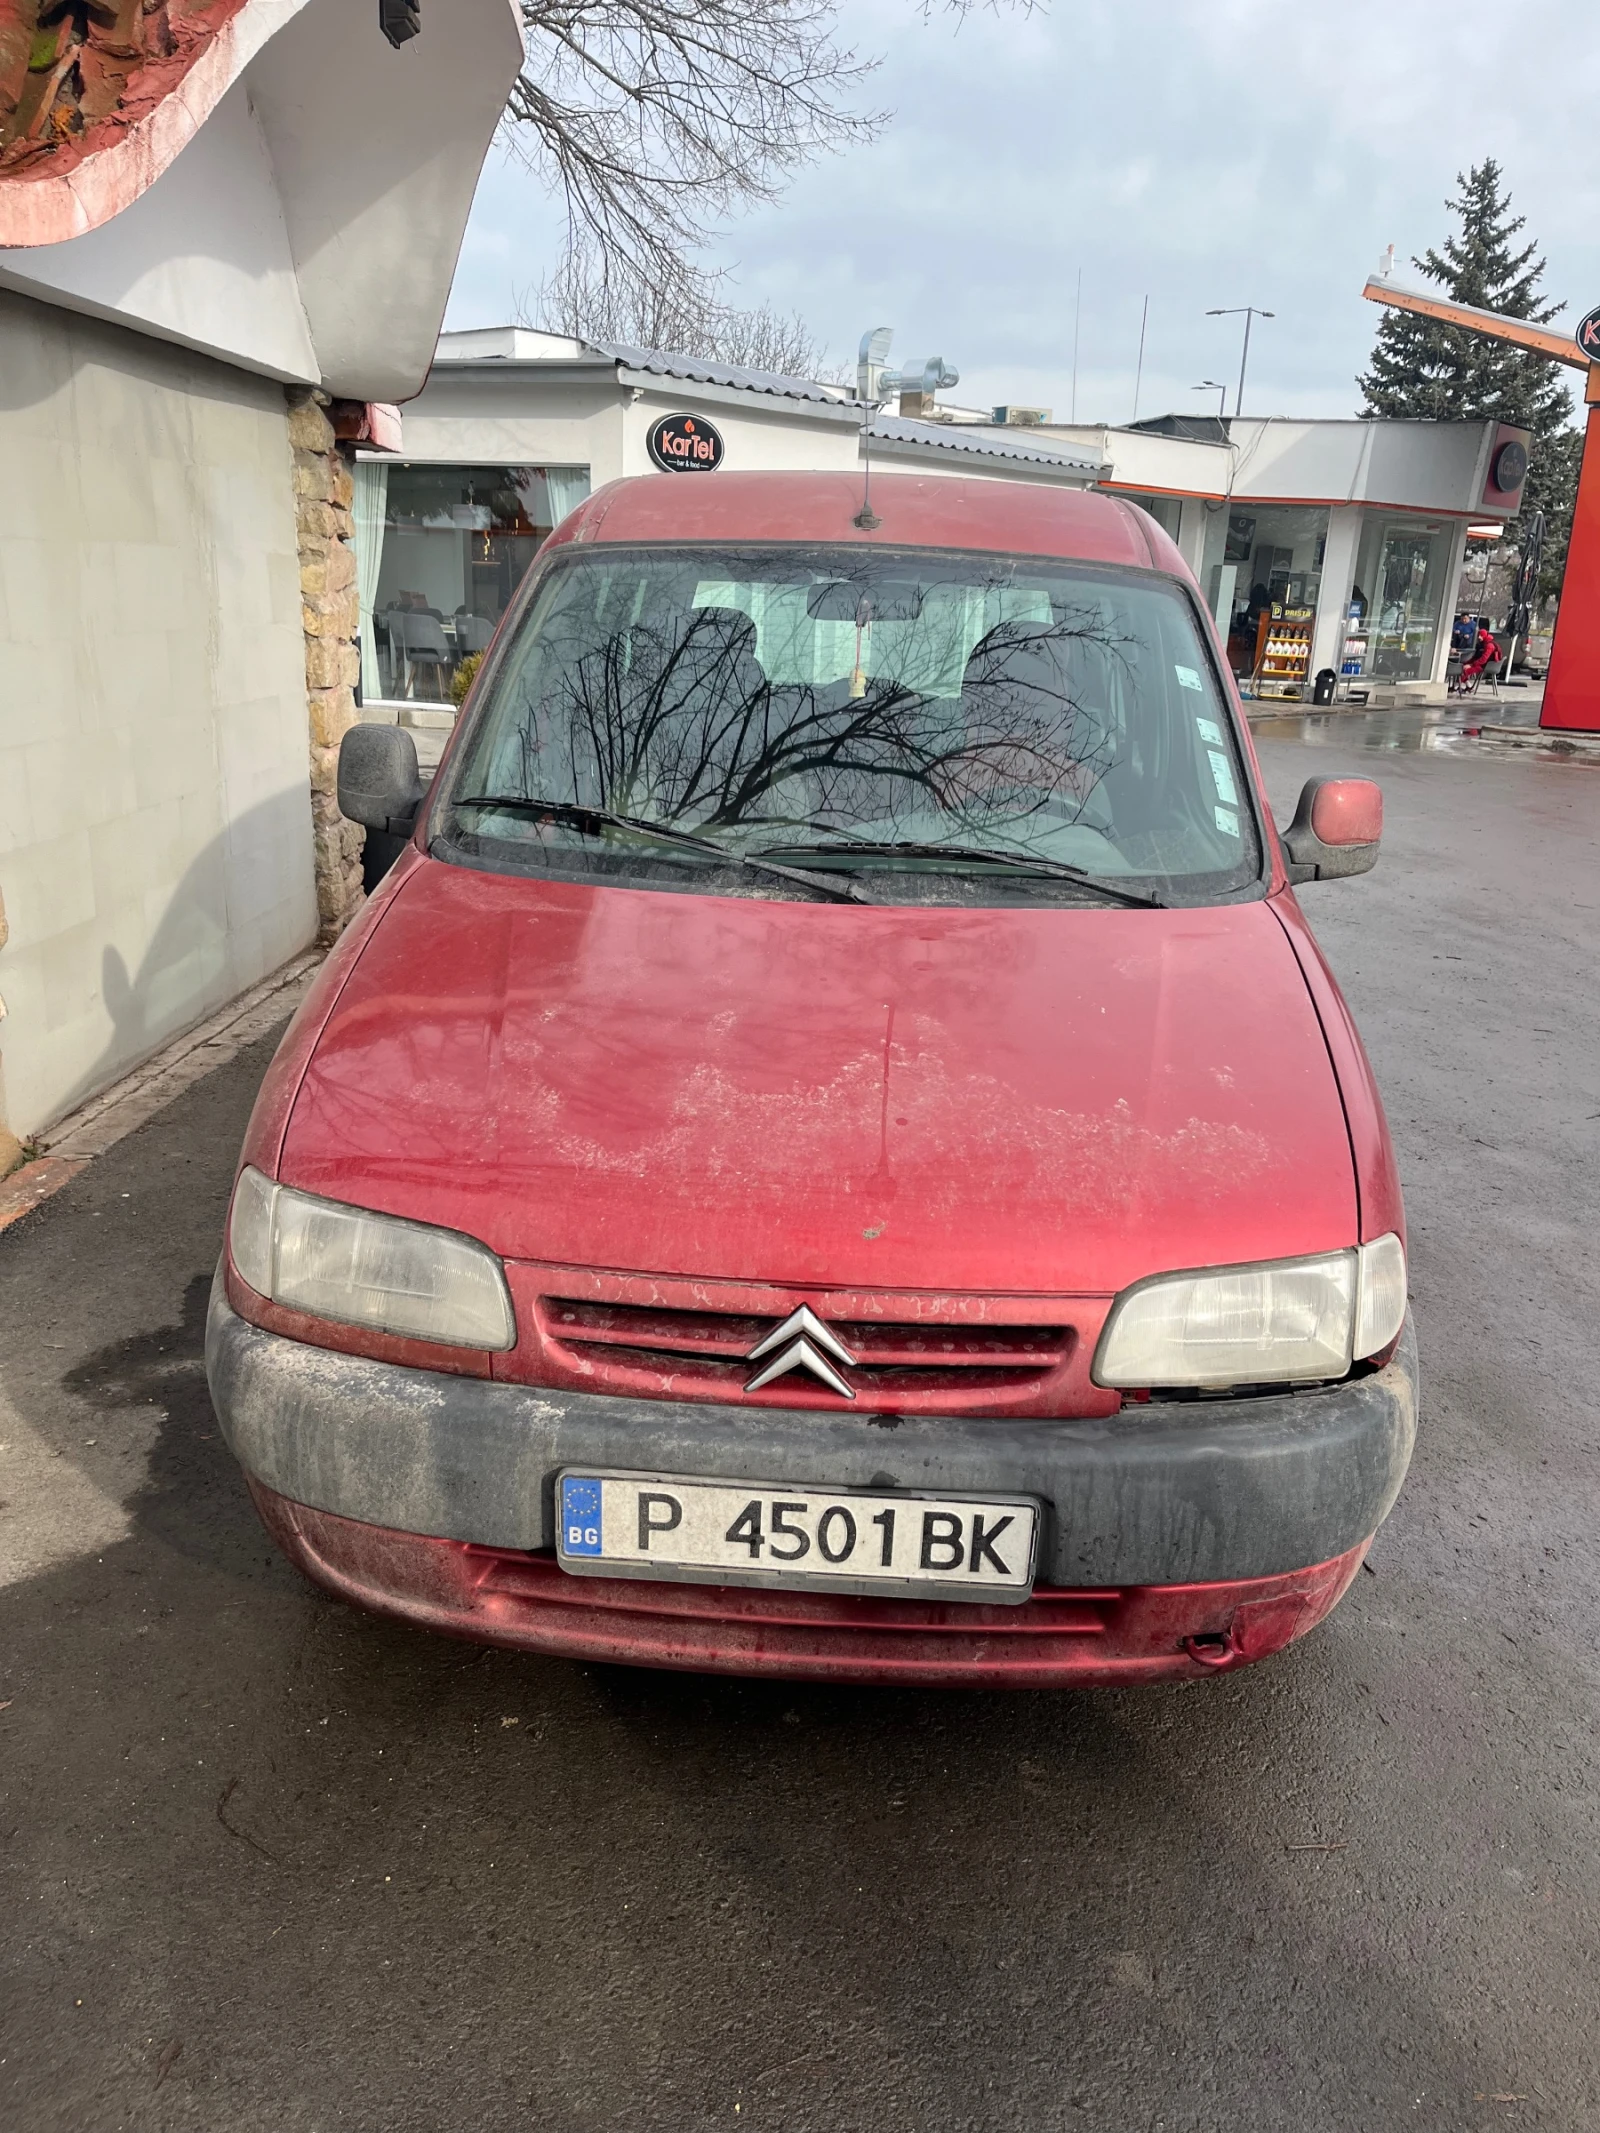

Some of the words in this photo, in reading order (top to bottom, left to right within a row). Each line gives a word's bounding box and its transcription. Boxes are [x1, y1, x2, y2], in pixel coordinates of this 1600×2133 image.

[662, 430, 715, 461] KarTel
[1285, 609, 1311, 617] PRISTA
[568, 1525, 598, 1546] BG
[637, 1491, 684, 1551] P
[724, 1499, 897, 1568] 4501
[920, 1510, 1016, 1576] BK
